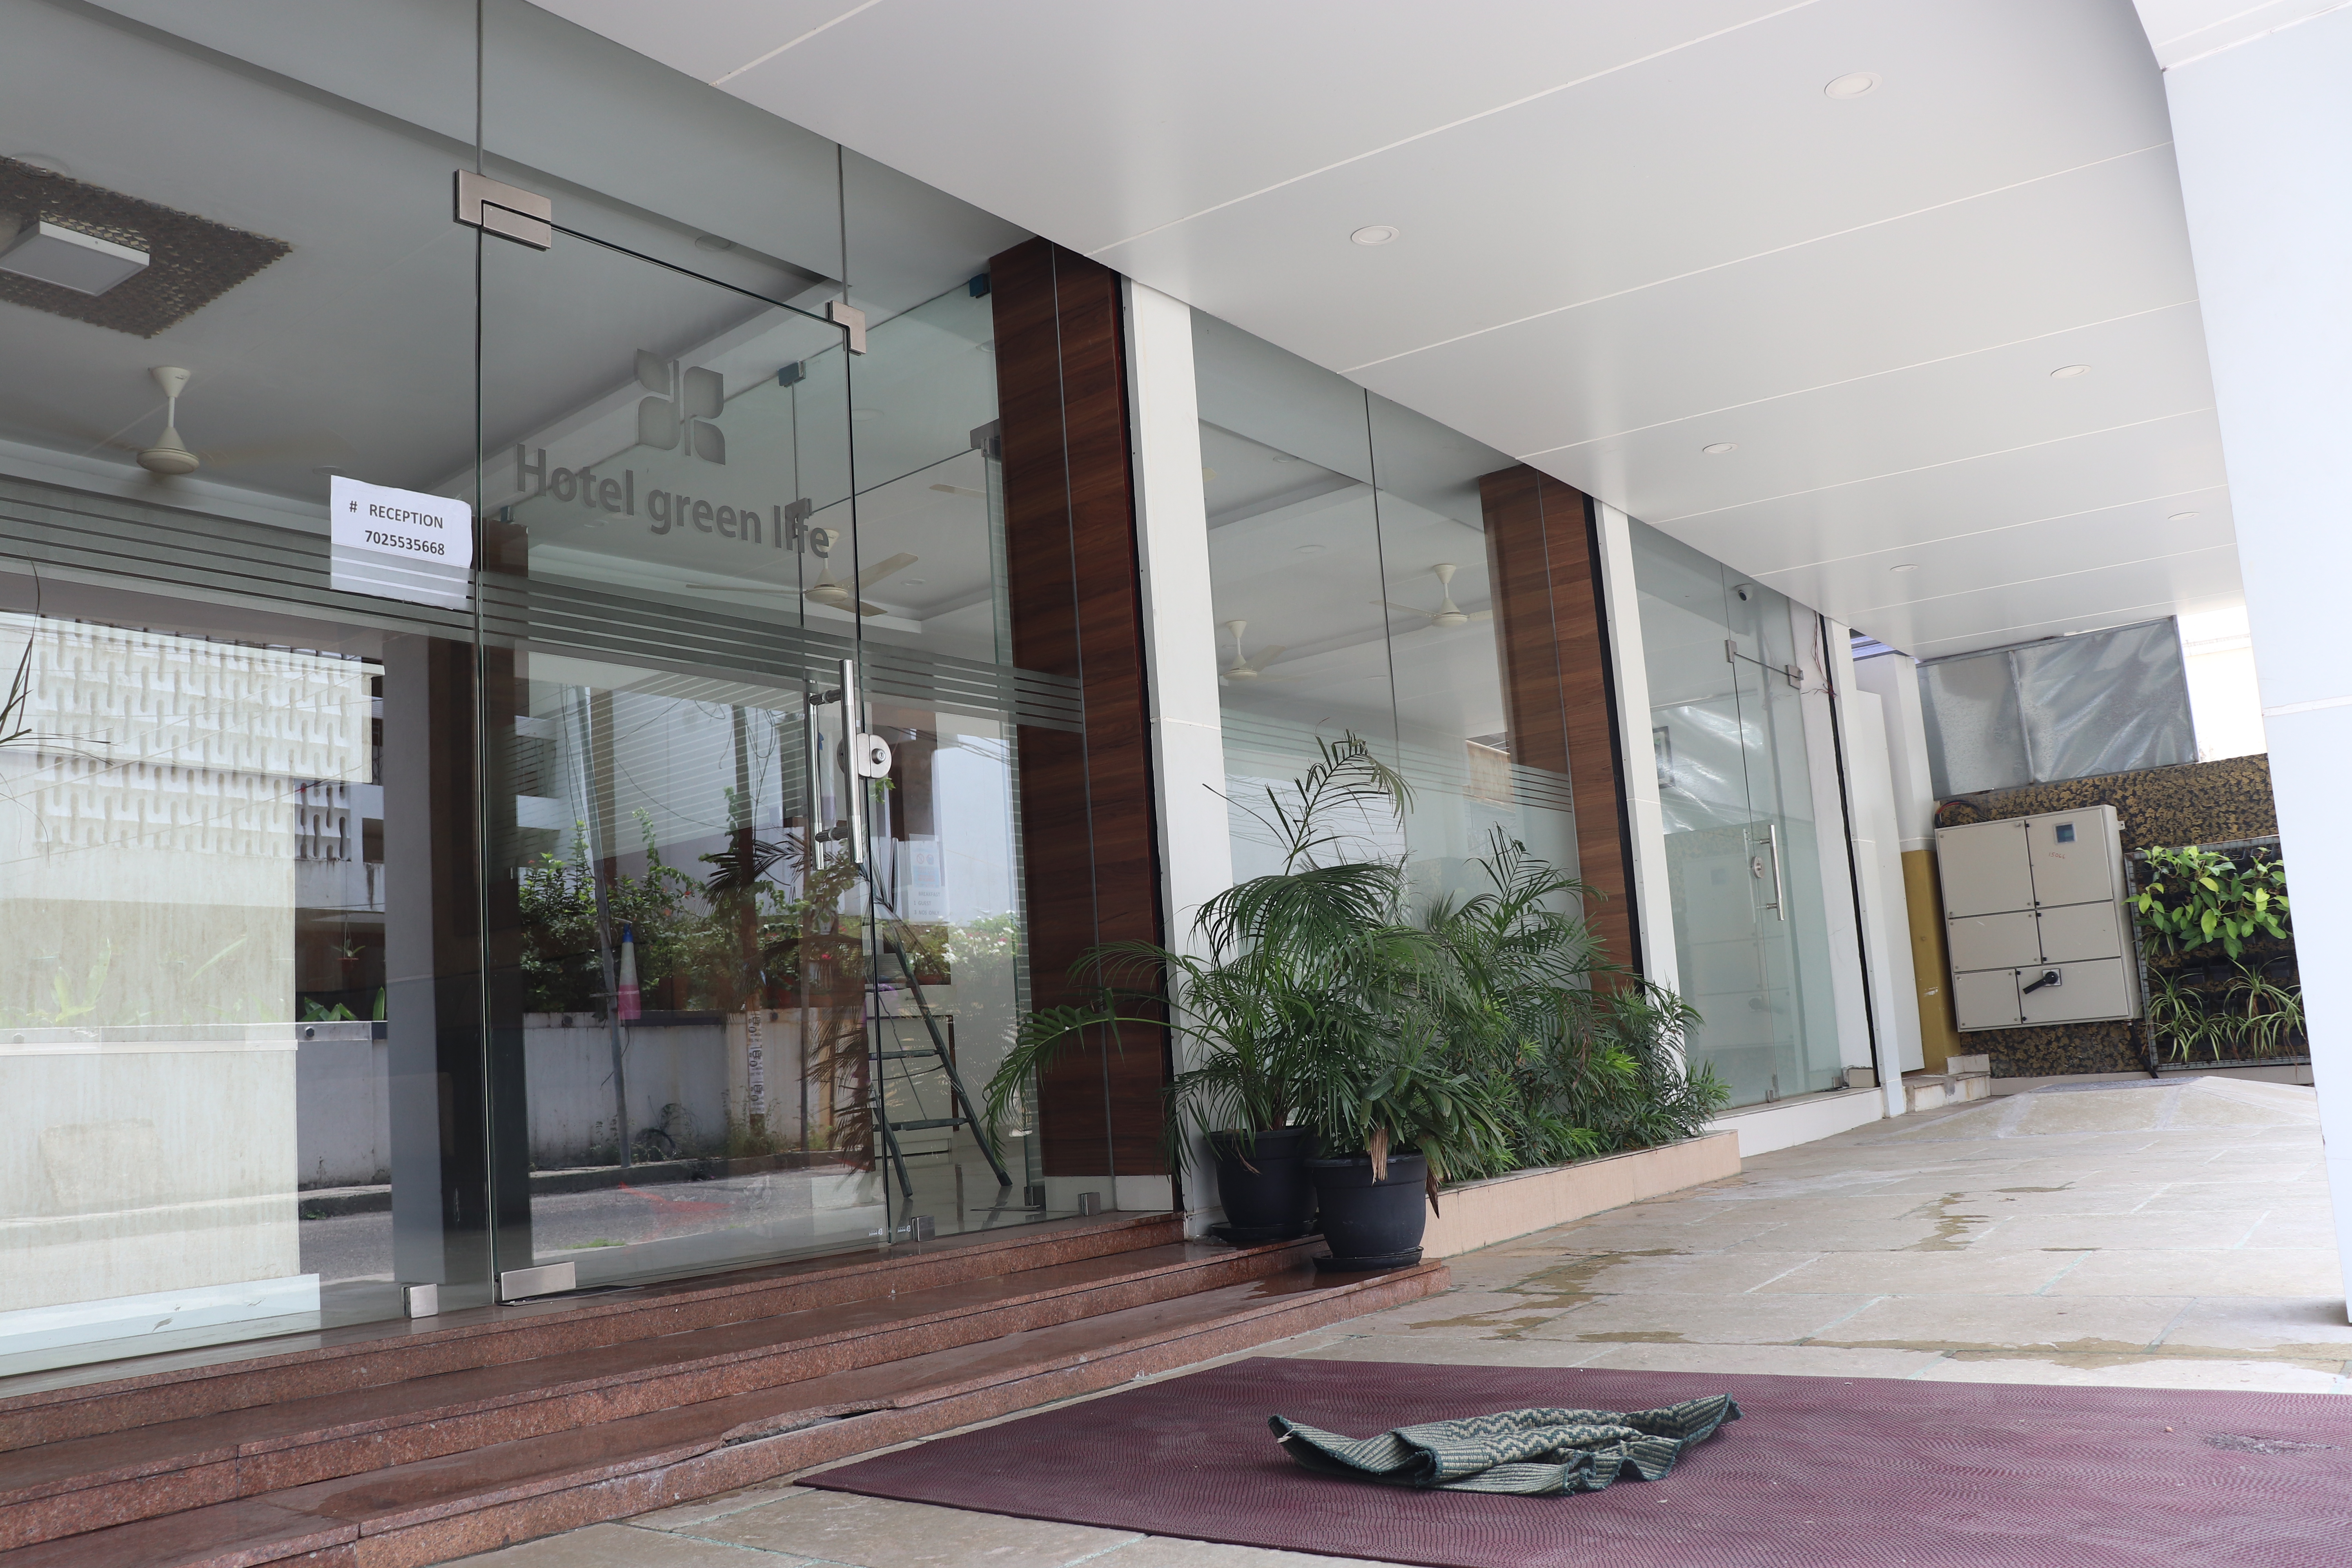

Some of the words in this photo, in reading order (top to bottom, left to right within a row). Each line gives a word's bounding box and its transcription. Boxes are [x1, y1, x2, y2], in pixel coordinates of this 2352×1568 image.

[517, 443, 634, 516] Hotel
[648, 489, 762, 544] green
[774, 505, 829, 558] life
[369, 504, 443, 529] RECEPTION
[365, 530, 445, 555] 7025535668
